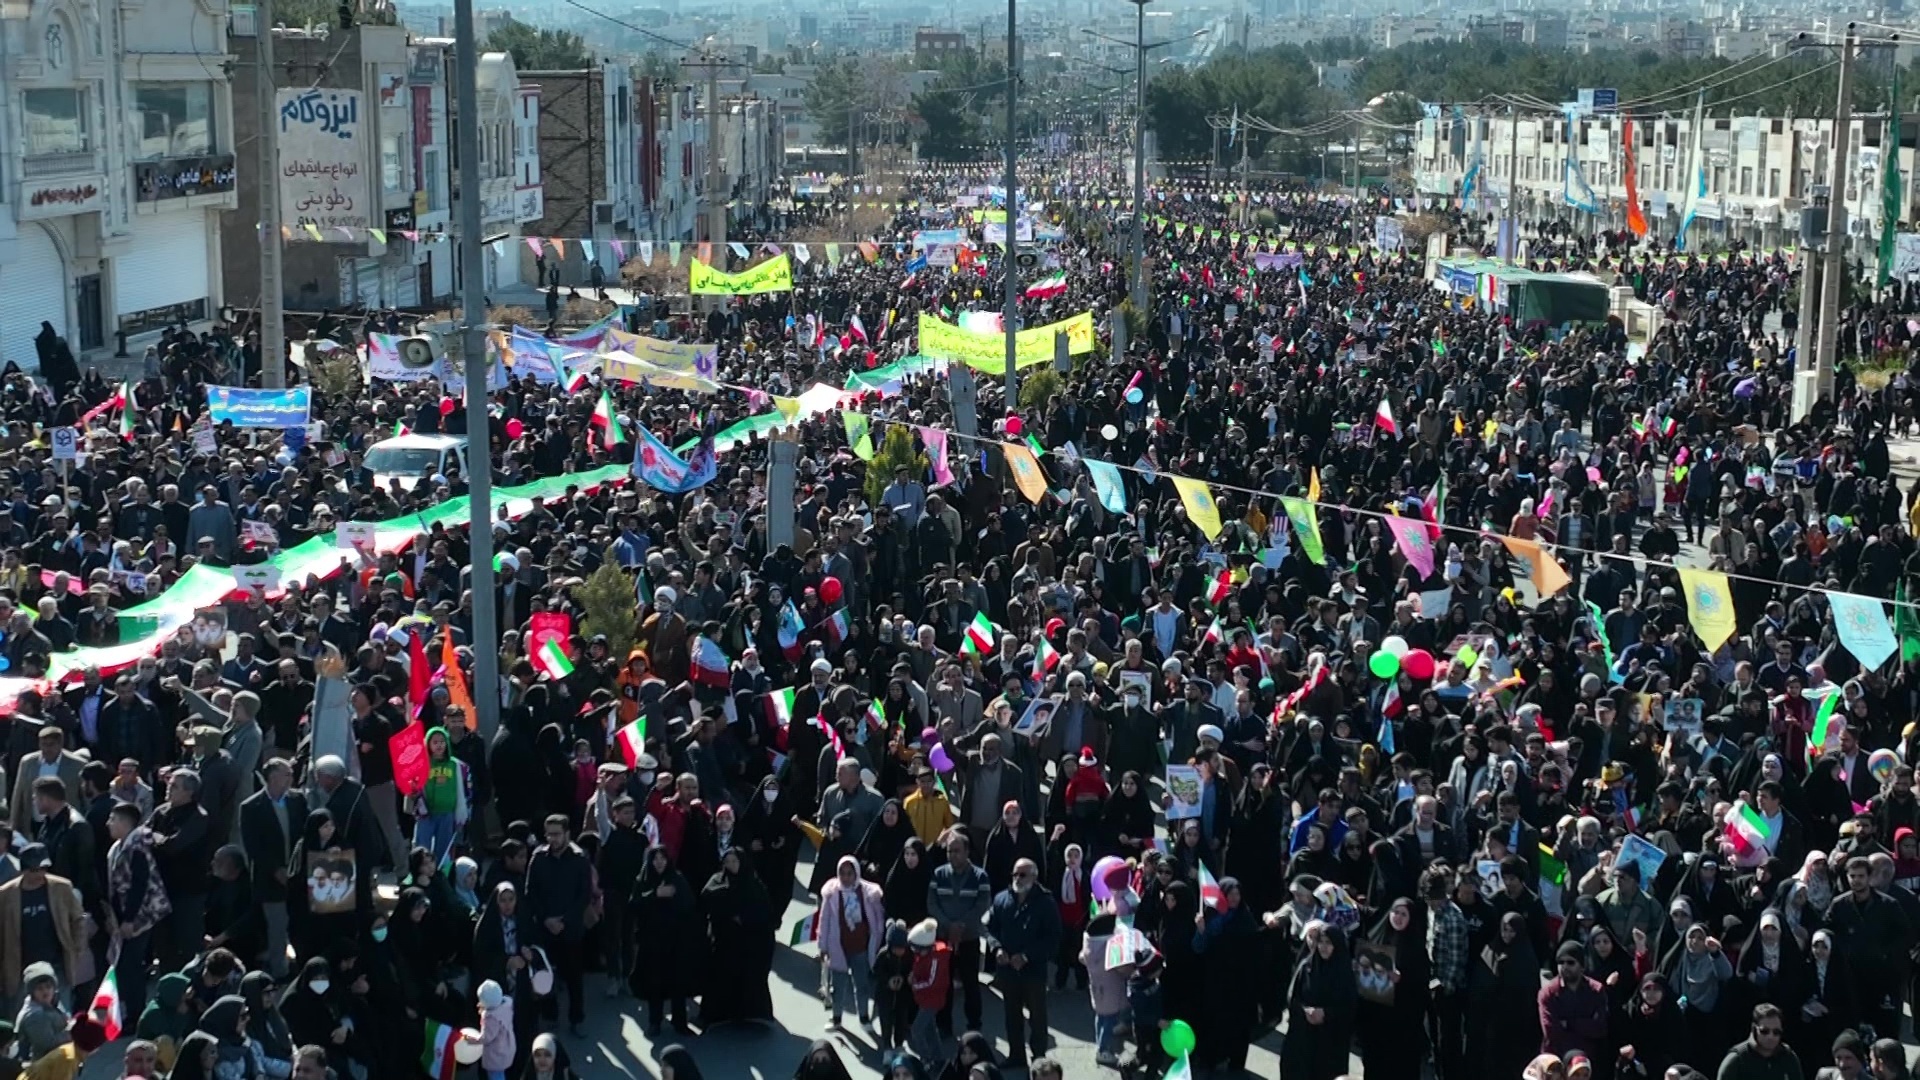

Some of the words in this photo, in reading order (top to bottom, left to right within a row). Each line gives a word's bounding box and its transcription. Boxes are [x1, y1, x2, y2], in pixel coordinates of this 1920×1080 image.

[281, 87, 357, 138] ایزوگام
[284, 158, 332, 179] عایقهای
[332, 161, 357, 180] انواع
